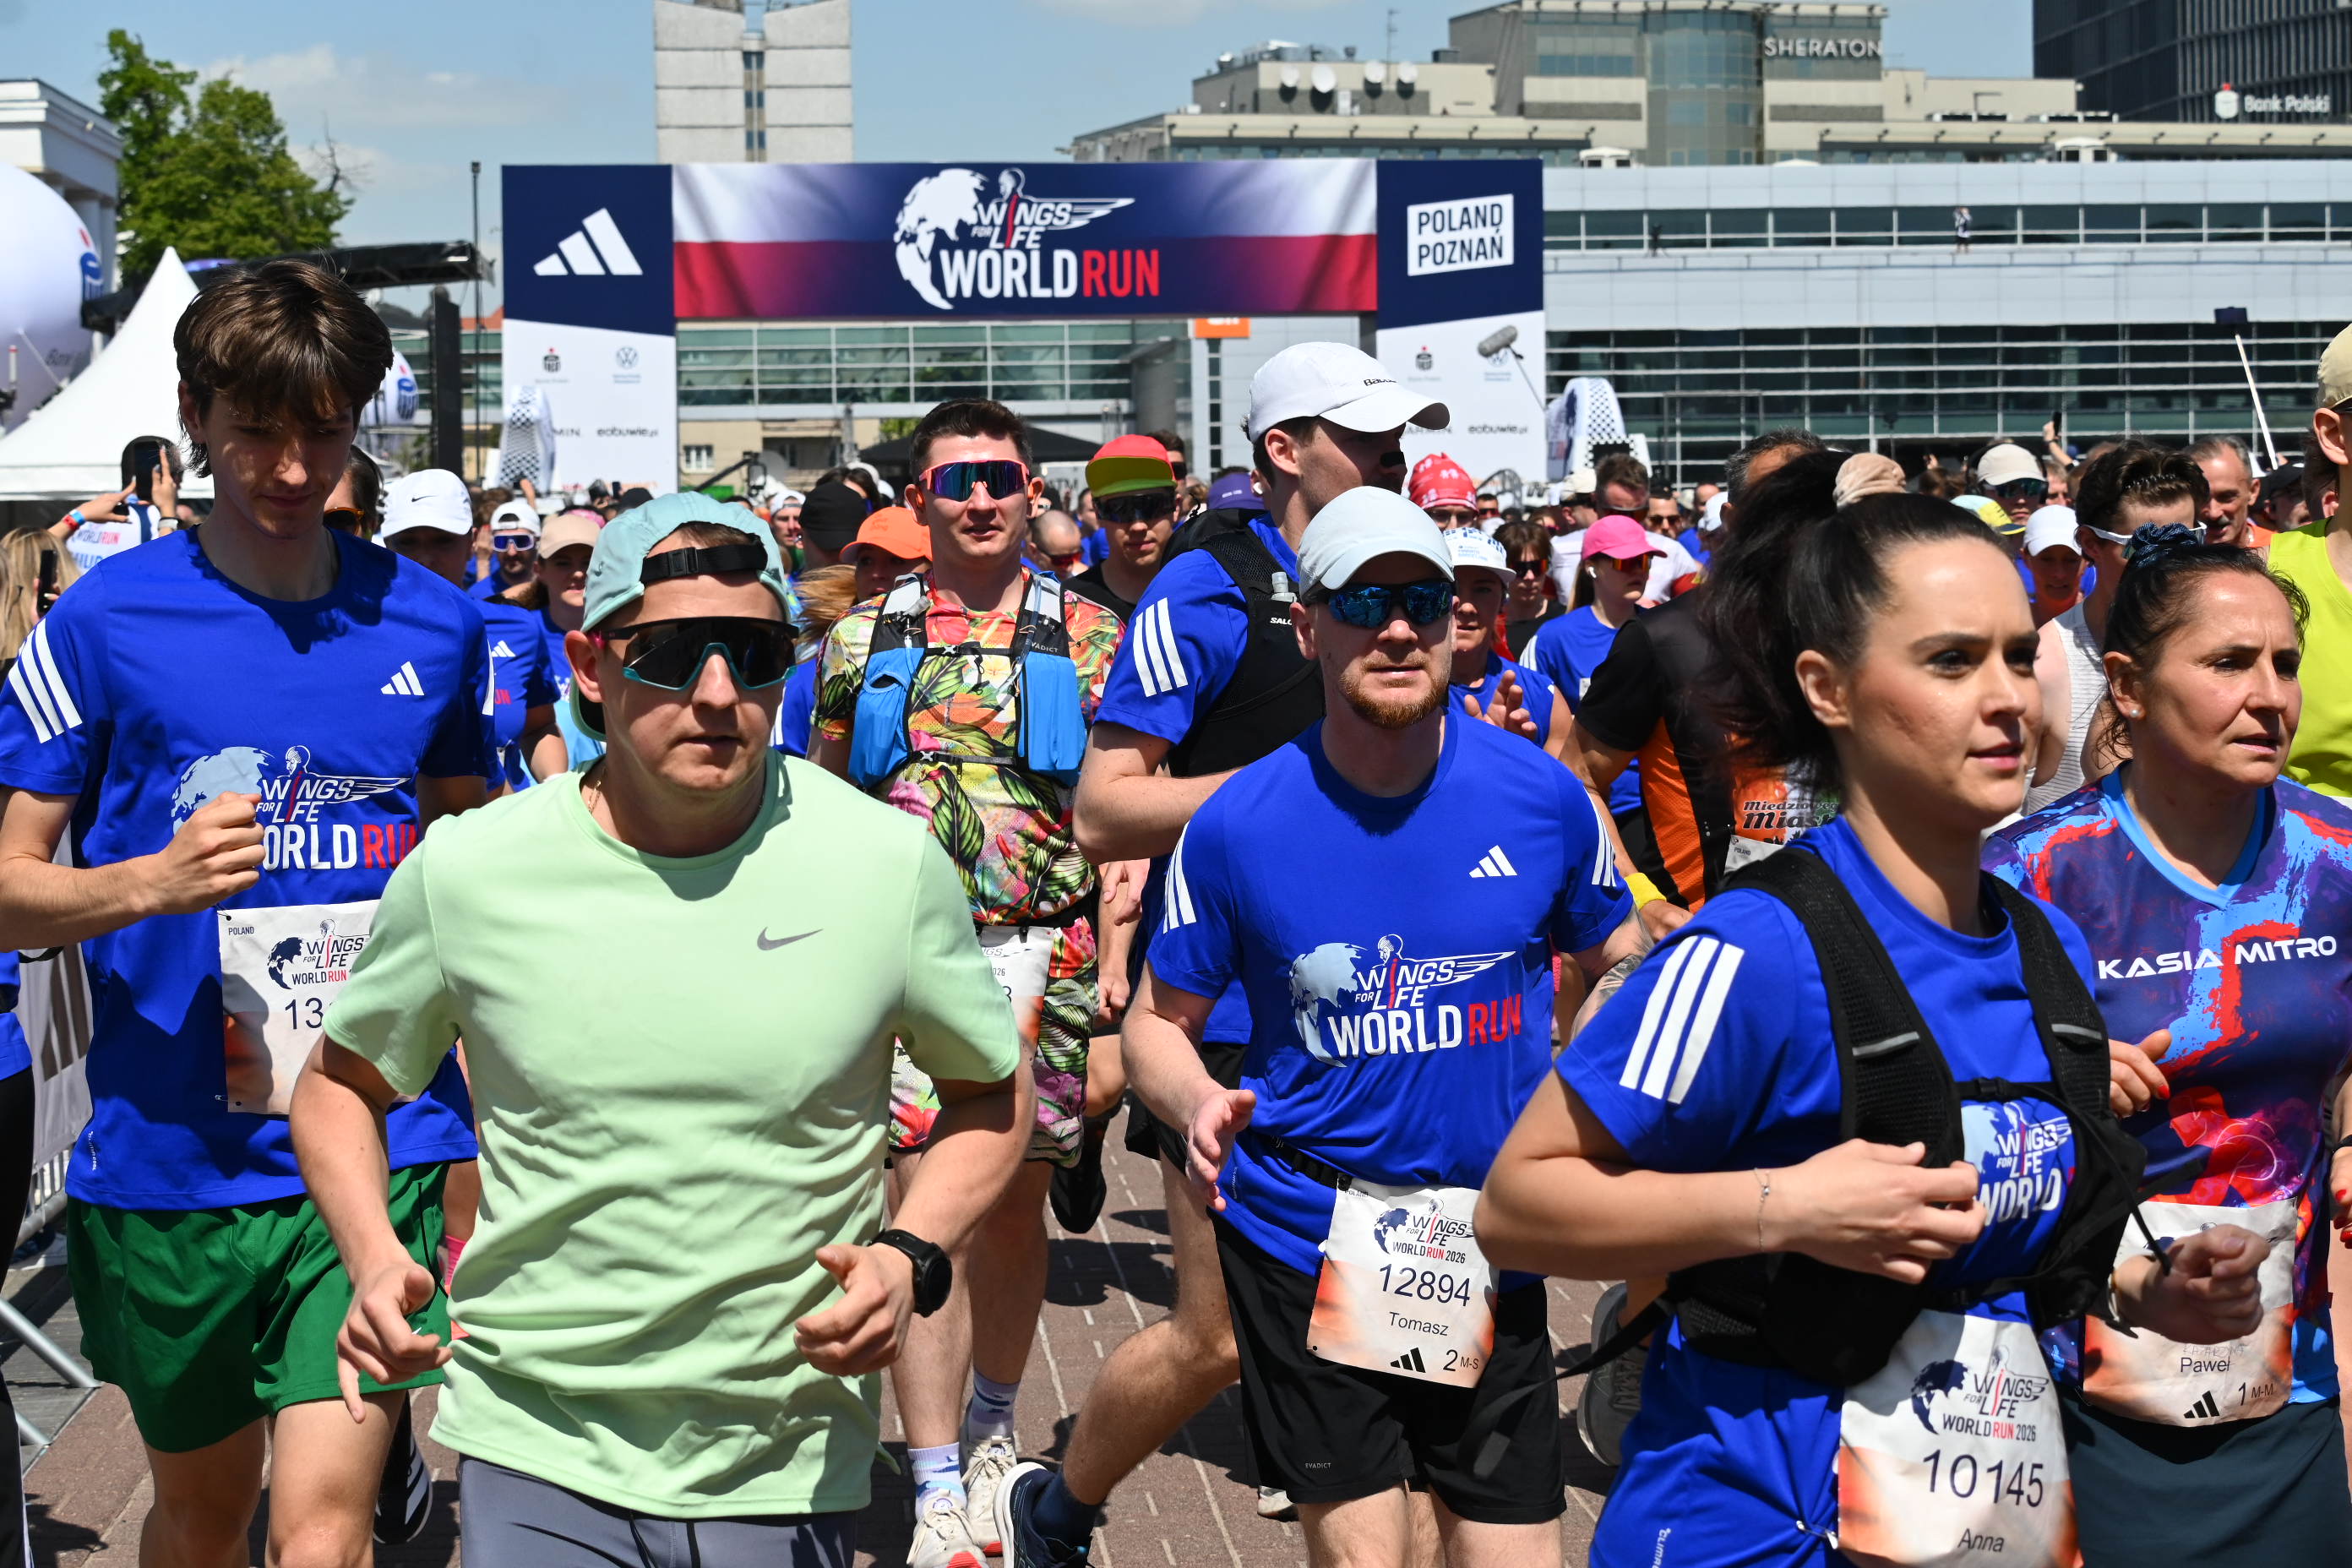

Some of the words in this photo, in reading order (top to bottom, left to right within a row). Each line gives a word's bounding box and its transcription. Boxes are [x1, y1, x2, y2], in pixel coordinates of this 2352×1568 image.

[1764, 36, 1883, 57] SHERATON
[2244, 93, 2281, 112] Bank
[2284, 94, 2330, 112] Polski
[977, 200, 1072, 226] WINGS
[1418, 203, 1503, 236] POLAND
[972, 226, 994, 237] FOR
[988, 225, 1045, 249] LIFE
[1418, 227, 1503, 268] POZNAŃ
[939, 248, 1078, 298] WORLD
[1082, 248, 1159, 297] RUN
[262, 770, 356, 802] WINGS
[255, 802, 276, 814] FOR
[271, 801, 325, 824] LIFE
[262, 824, 358, 872] ORLD
[1734, 847, 1751, 857] POLAND
[228, 926, 255, 936] POLAND
[306, 935, 365, 956] WINGS
[2098, 948, 2224, 980] KASIA
[2235, 935, 2338, 965] MITRO
[315, 954, 349, 970] LIFE
[1357, 958, 1456, 991] WINGS
[291, 973, 328, 986] WORLD
[328, 970, 347, 983] RUN
[1354, 991, 1375, 1003] FOR
[1372, 985, 1429, 1010] LIFE
[285, 997, 327, 1030] 13
[1327, 1004, 1462, 1059] WORLD
[1467, 993, 1522, 1047] RUN
[1997, 1123, 2059, 1156] WINGS
[1995, 1157, 2012, 1169] FOR
[2009, 1150, 2043, 1179] LIFE
[1413, 1214, 1467, 1236] WINGS
[1416, 1229, 1451, 1247] LIFE
[1392, 1241, 1426, 1257] WORLD
[1426, 1246, 1445, 1260] RUN
[1446, 1250, 1466, 1265] 2026
[1379, 1263, 1472, 1308] 12894
[1388, 1311, 1450, 1337] Tomasz
[1442, 1348, 1459, 1372] 2
[1460, 1356, 1479, 1370] M-S
[1974, 1369, 2034, 1399] WINGS
[2239, 1382, 2247, 1407] 1
[2251, 1383, 2274, 1399] M-M
[1963, 1393, 1982, 1404] FOR
[1979, 1397, 2019, 1419] LIFE
[1943, 1413, 1991, 1437] WORLD
[1992, 1420, 2014, 1440] RUN
[2016, 1424, 2037, 1442] 2026
[1923, 1448, 2044, 1508] 10145
[1957, 1527, 2006, 1553] Anna
